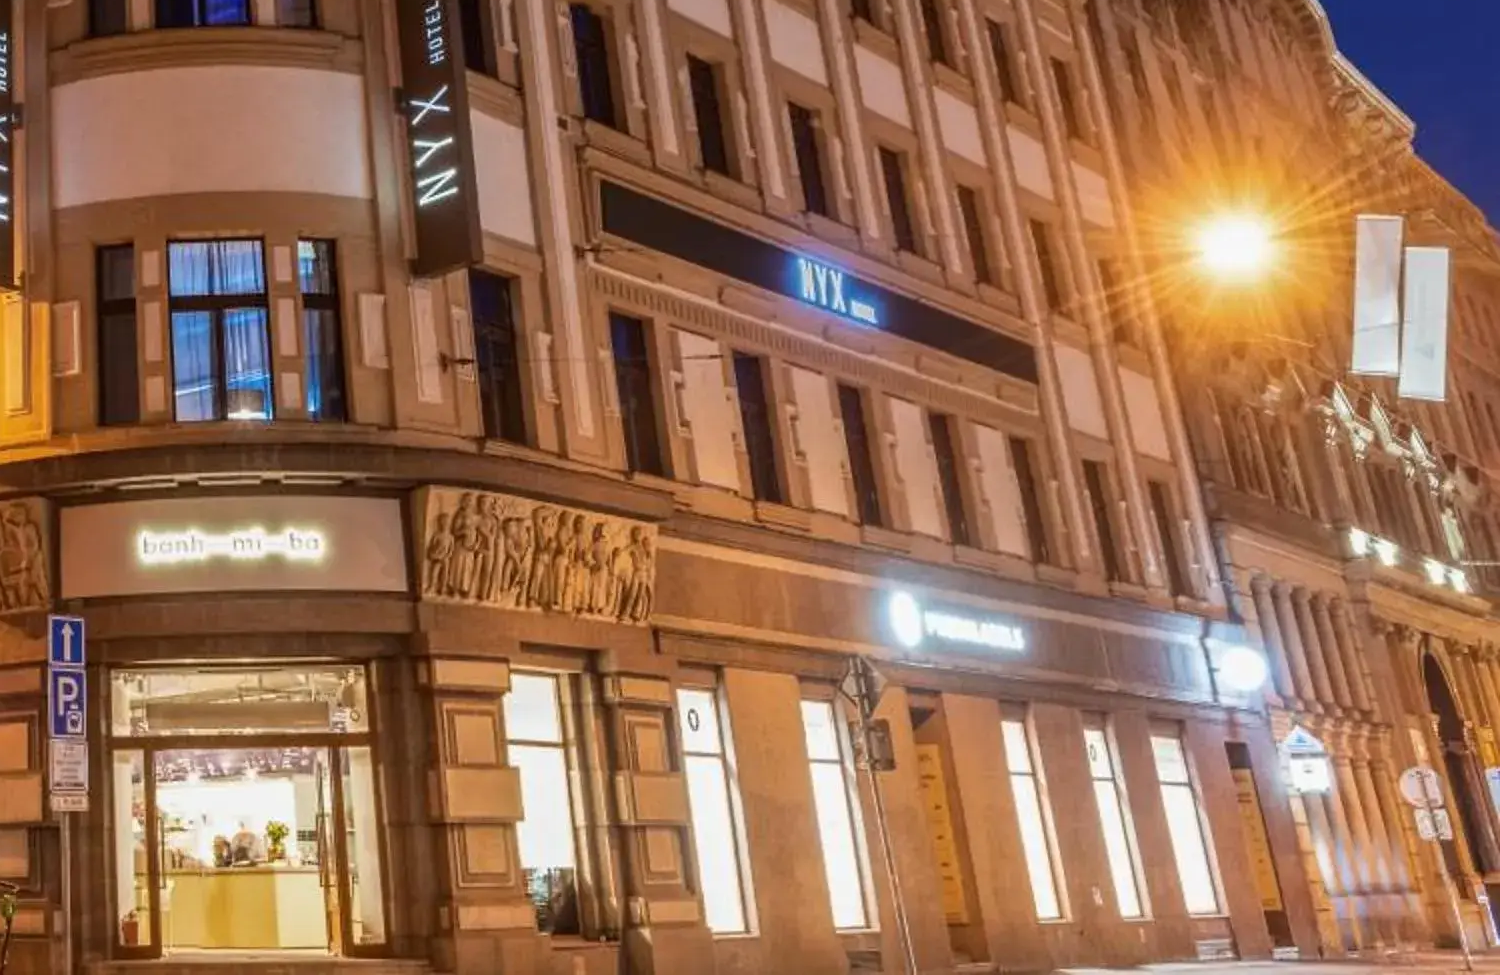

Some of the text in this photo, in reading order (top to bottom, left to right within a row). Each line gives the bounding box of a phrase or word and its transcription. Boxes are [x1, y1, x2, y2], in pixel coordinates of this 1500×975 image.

[409, 84, 459, 207] NYX
[798, 257, 848, 314] NYX
[57, 675, 79, 717] P
